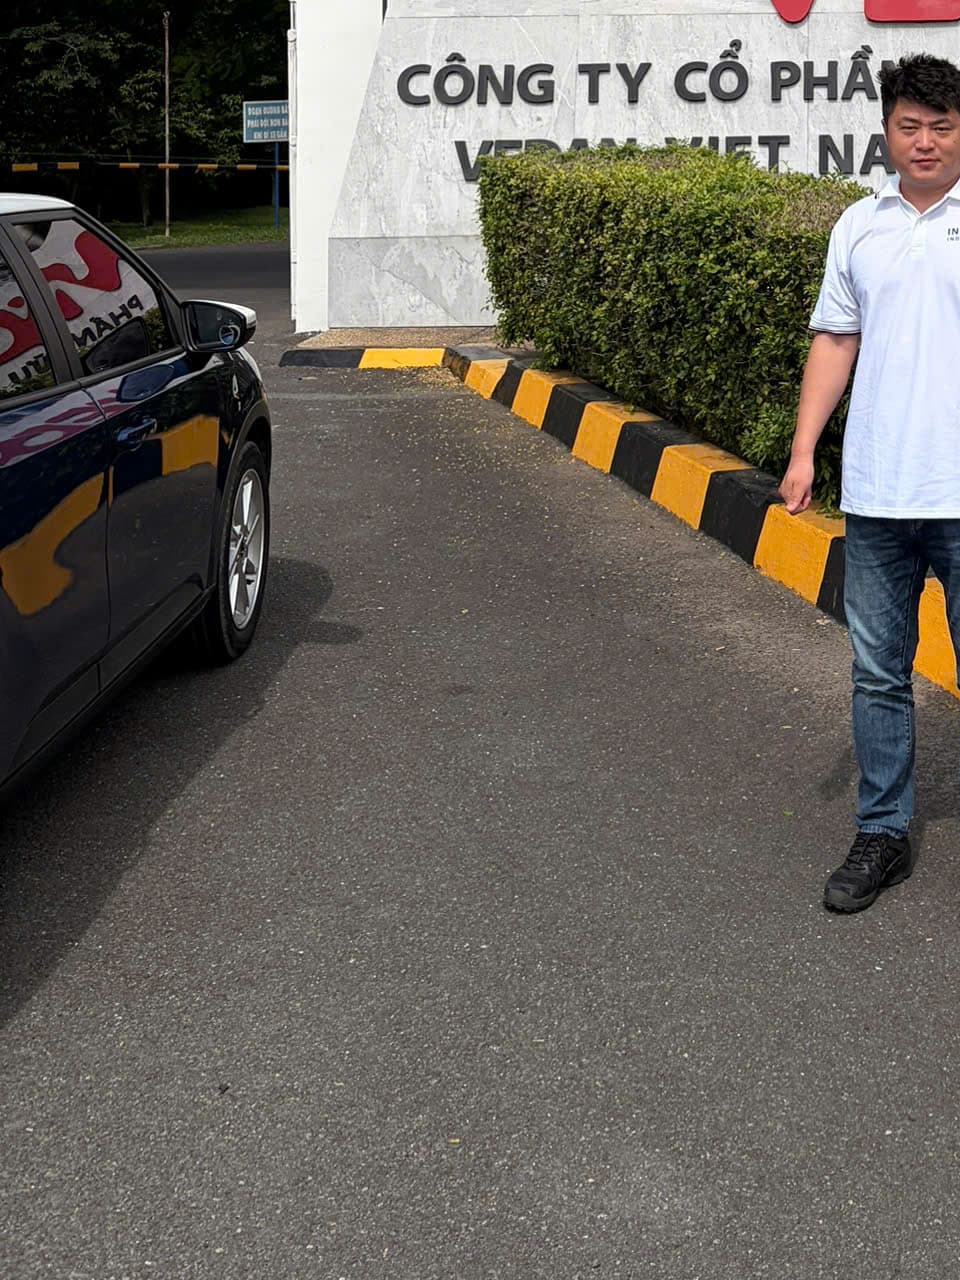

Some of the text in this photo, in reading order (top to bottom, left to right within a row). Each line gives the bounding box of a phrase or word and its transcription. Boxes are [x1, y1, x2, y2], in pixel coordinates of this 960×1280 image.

[396, 52, 556, 106] CÔNG
[577, 62, 653, 104] TY
[673, 38, 750, 103] CỔ
[770, 45, 901, 101] PHẦ
[818, 133, 897, 176] NA
